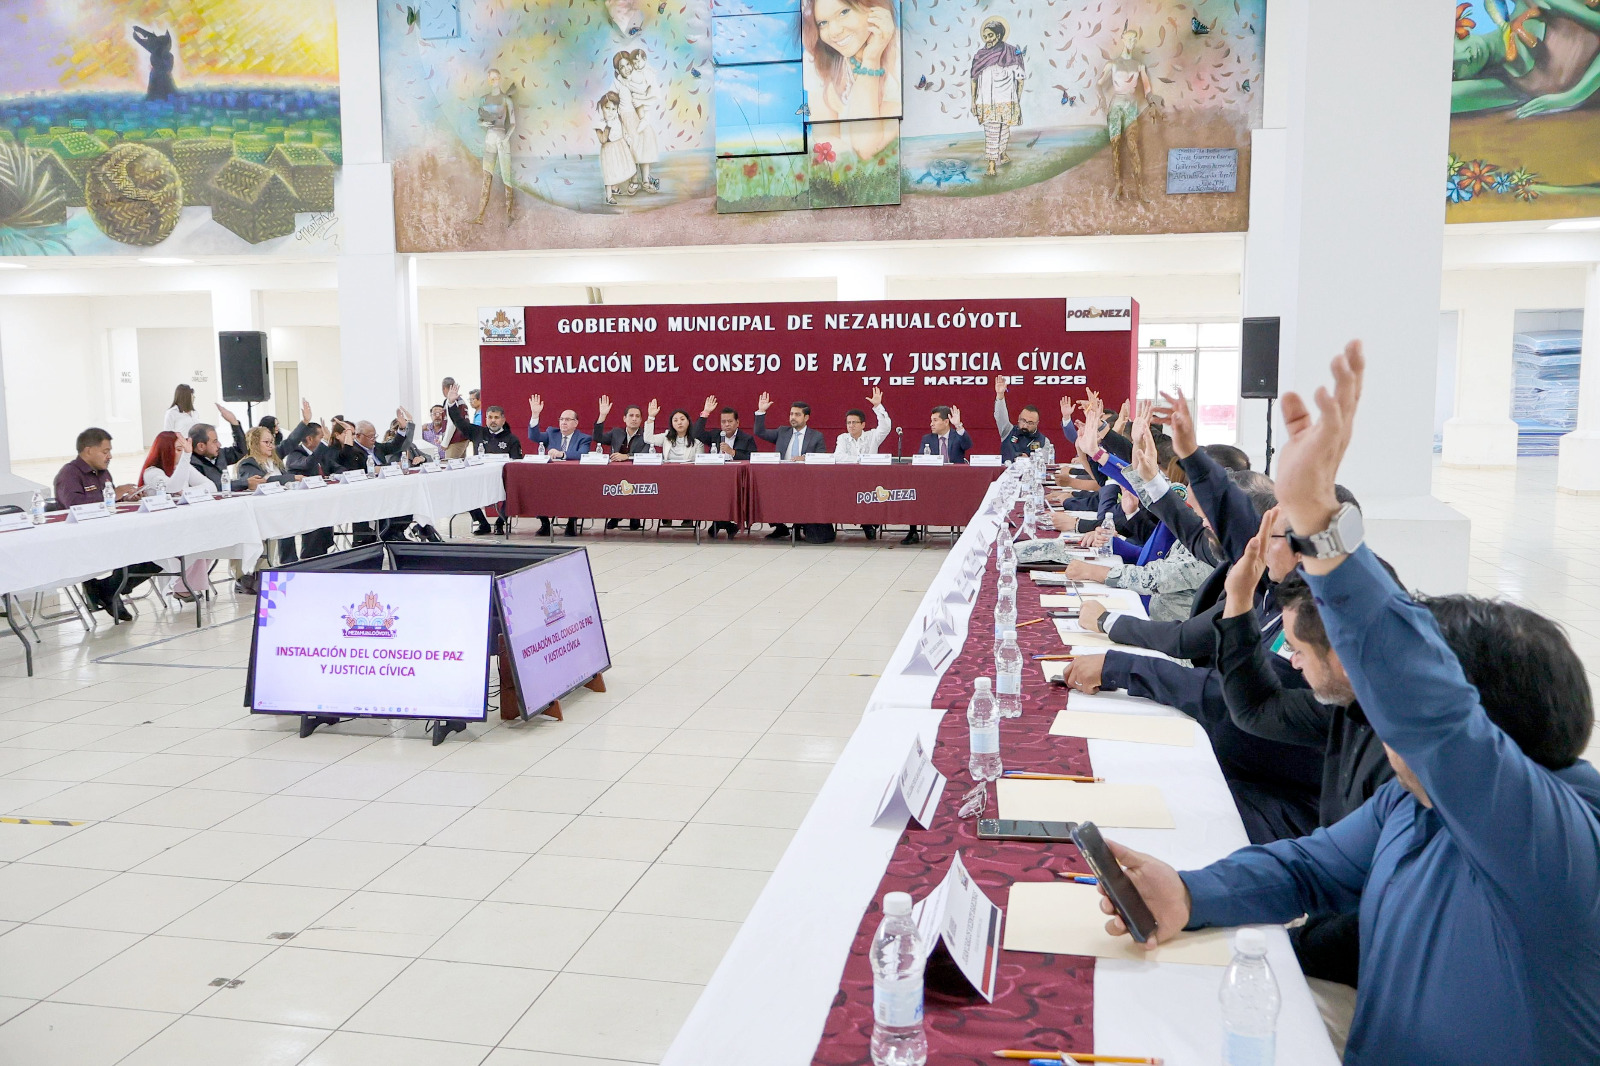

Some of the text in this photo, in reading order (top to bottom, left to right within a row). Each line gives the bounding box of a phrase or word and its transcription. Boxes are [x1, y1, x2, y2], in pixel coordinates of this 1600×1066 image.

[558, 307, 1022, 333] GOBIERNO MUNICIPAL DE NEZAHUALCÓYOTL
[1067, 309, 1130, 318] POR NEZA
[515, 348, 1086, 374] INSTALACIÓN DEL CONSEJO DE PAZ Y JUSTICIA CÍVICA
[862, 376, 881, 386] 17
[889, 376, 915, 386] DE
[924, 376, 988, 386] MARZO
[1033, 375, 1087, 385] 2026
[603, 483, 658, 496] POR NEZA
[857, 489, 916, 503] POR NEZA
[522, 616, 593, 659] INSTALACIÓN DEL CONSEJO DE PAZ
[276, 645, 464, 661] INSTALACIÓN DEL CONSEJO DE PAZ
[548, 645, 567, 663] JUSTICIA
[567, 638, 581, 652] CÍVICA
[321, 664, 416, 677] Y JUSTICIA CÍVICA
